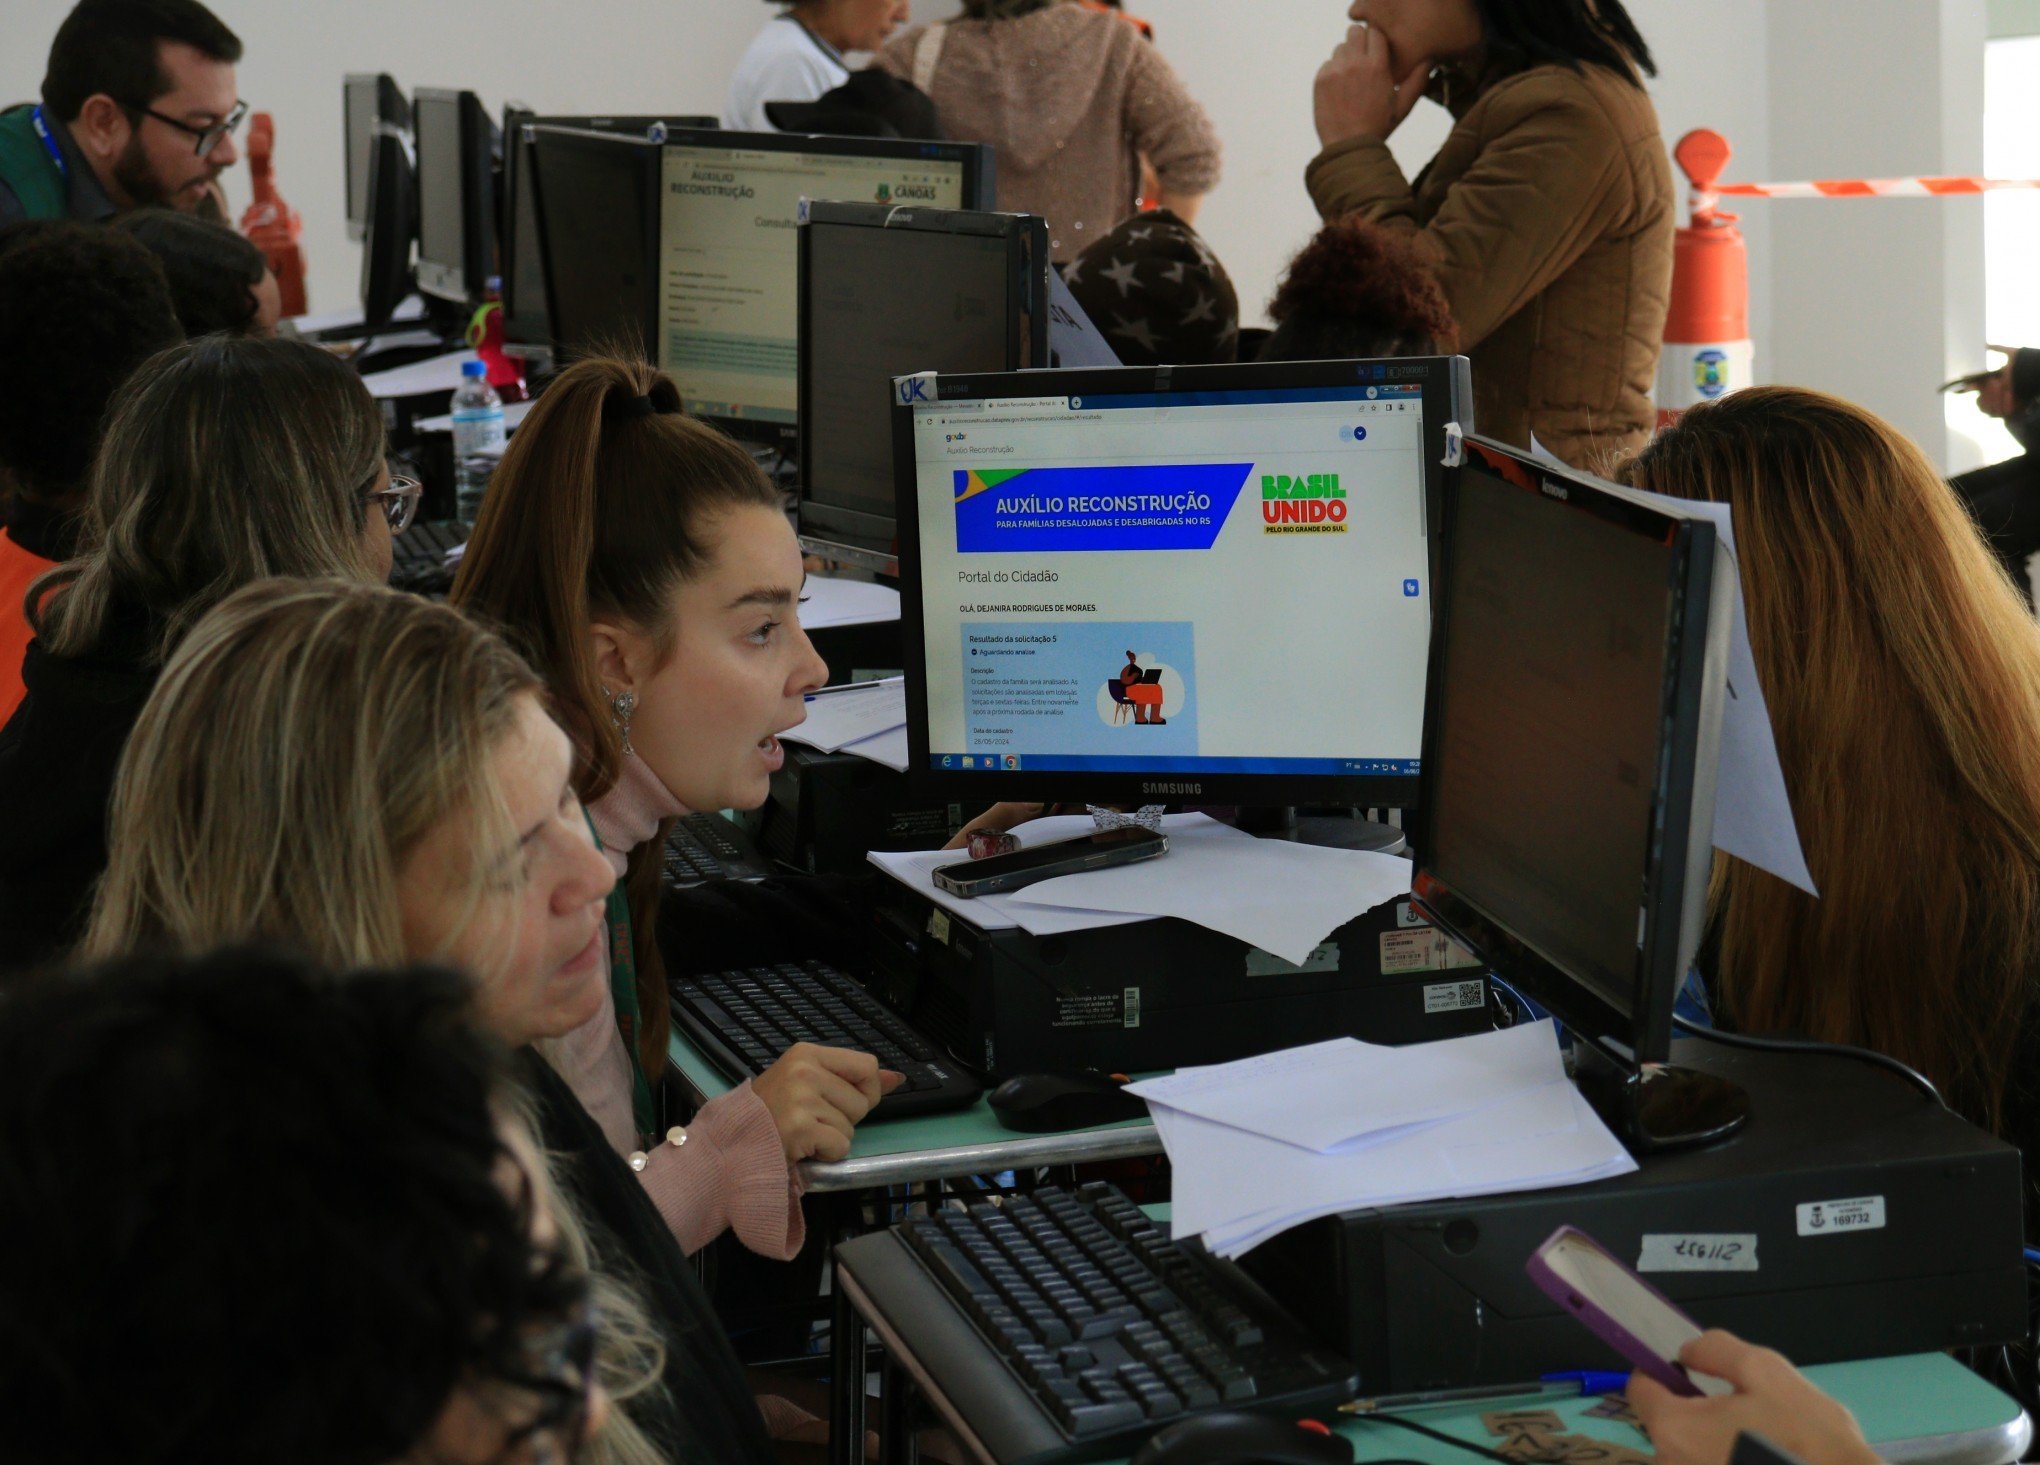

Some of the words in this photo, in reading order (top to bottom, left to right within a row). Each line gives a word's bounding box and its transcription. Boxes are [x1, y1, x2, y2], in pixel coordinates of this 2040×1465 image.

[670, 182, 754, 199] RECONSTRUÇÃO
[895, 185, 936, 200] CANOAS
[900, 376, 928, 403] OK
[969, 445, 1014, 456] Reconstrução
[1261, 474, 1346, 499] BRASIL
[996, 494, 1063, 514] AUXÍLIO
[1068, 491, 1211, 515] RECONSTRUÇÃO
[1262, 499, 1347, 524] UNIDO
[997, 520, 1017, 528] PARA
[1018, 518, 1055, 528] FAMÍLIAS
[1056, 518, 1113, 527] DESALOJADAS
[1115, 518, 1120, 526] E
[1121, 517, 1184, 526] DESABRIGADAS
[1185, 517, 1198, 525] NO
[1199, 517, 1211, 525] RS
[958, 570, 991, 583] Portal
[993, 570, 1008, 583] do
[1011, 569, 1059, 583] Cidadão
[960, 603, 976, 613] OLÁ,
[977, 604, 1011, 613] DEJANIRA
[1012, 604, 1053, 612] RODRIGUES
[1054, 604, 1064, 612] DE
[970, 635, 1003, 643] Resultado
[1004, 635, 1014, 643] da
[1014, 635, 1051, 645] solicitação
[1052, 635, 1057, 643] 5
[980, 649, 1014, 657] Aguardando
[1142, 782, 1202, 795] SAMSUNG
[1833, 1212, 1870, 1225] 169732
